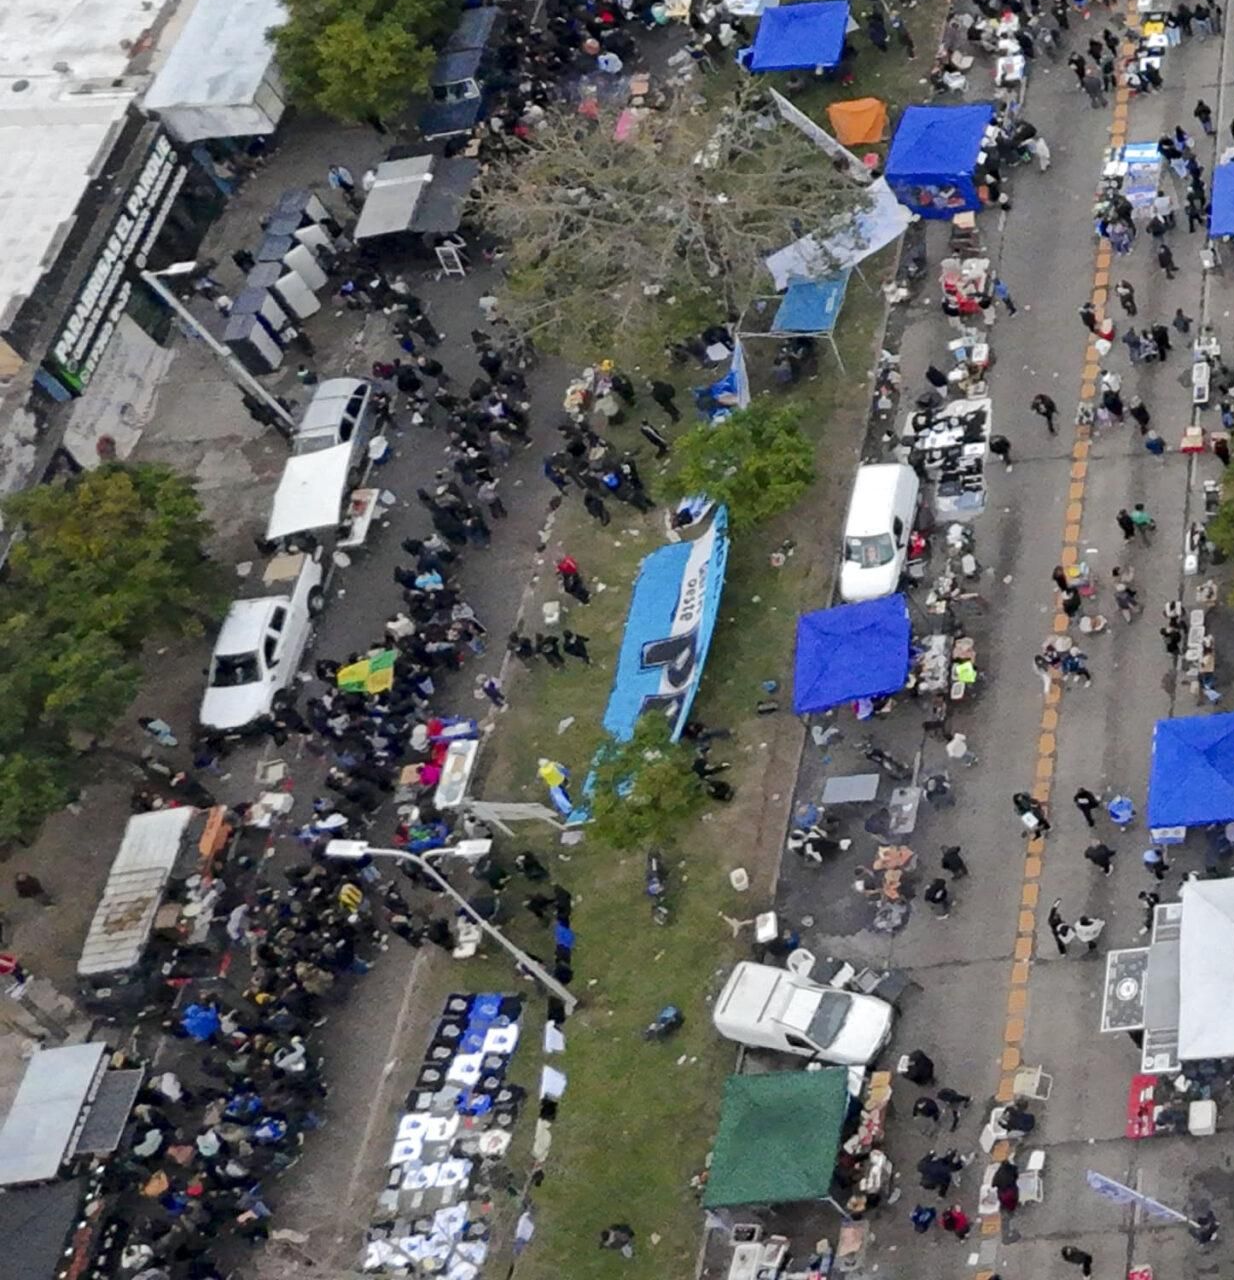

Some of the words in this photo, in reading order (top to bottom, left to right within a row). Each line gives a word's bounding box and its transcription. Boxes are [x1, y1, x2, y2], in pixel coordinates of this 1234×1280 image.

[54, 233, 122, 366] PARABRISAS
[115, 214, 135, 242] EL
[126, 133, 171, 218] PARQUE
